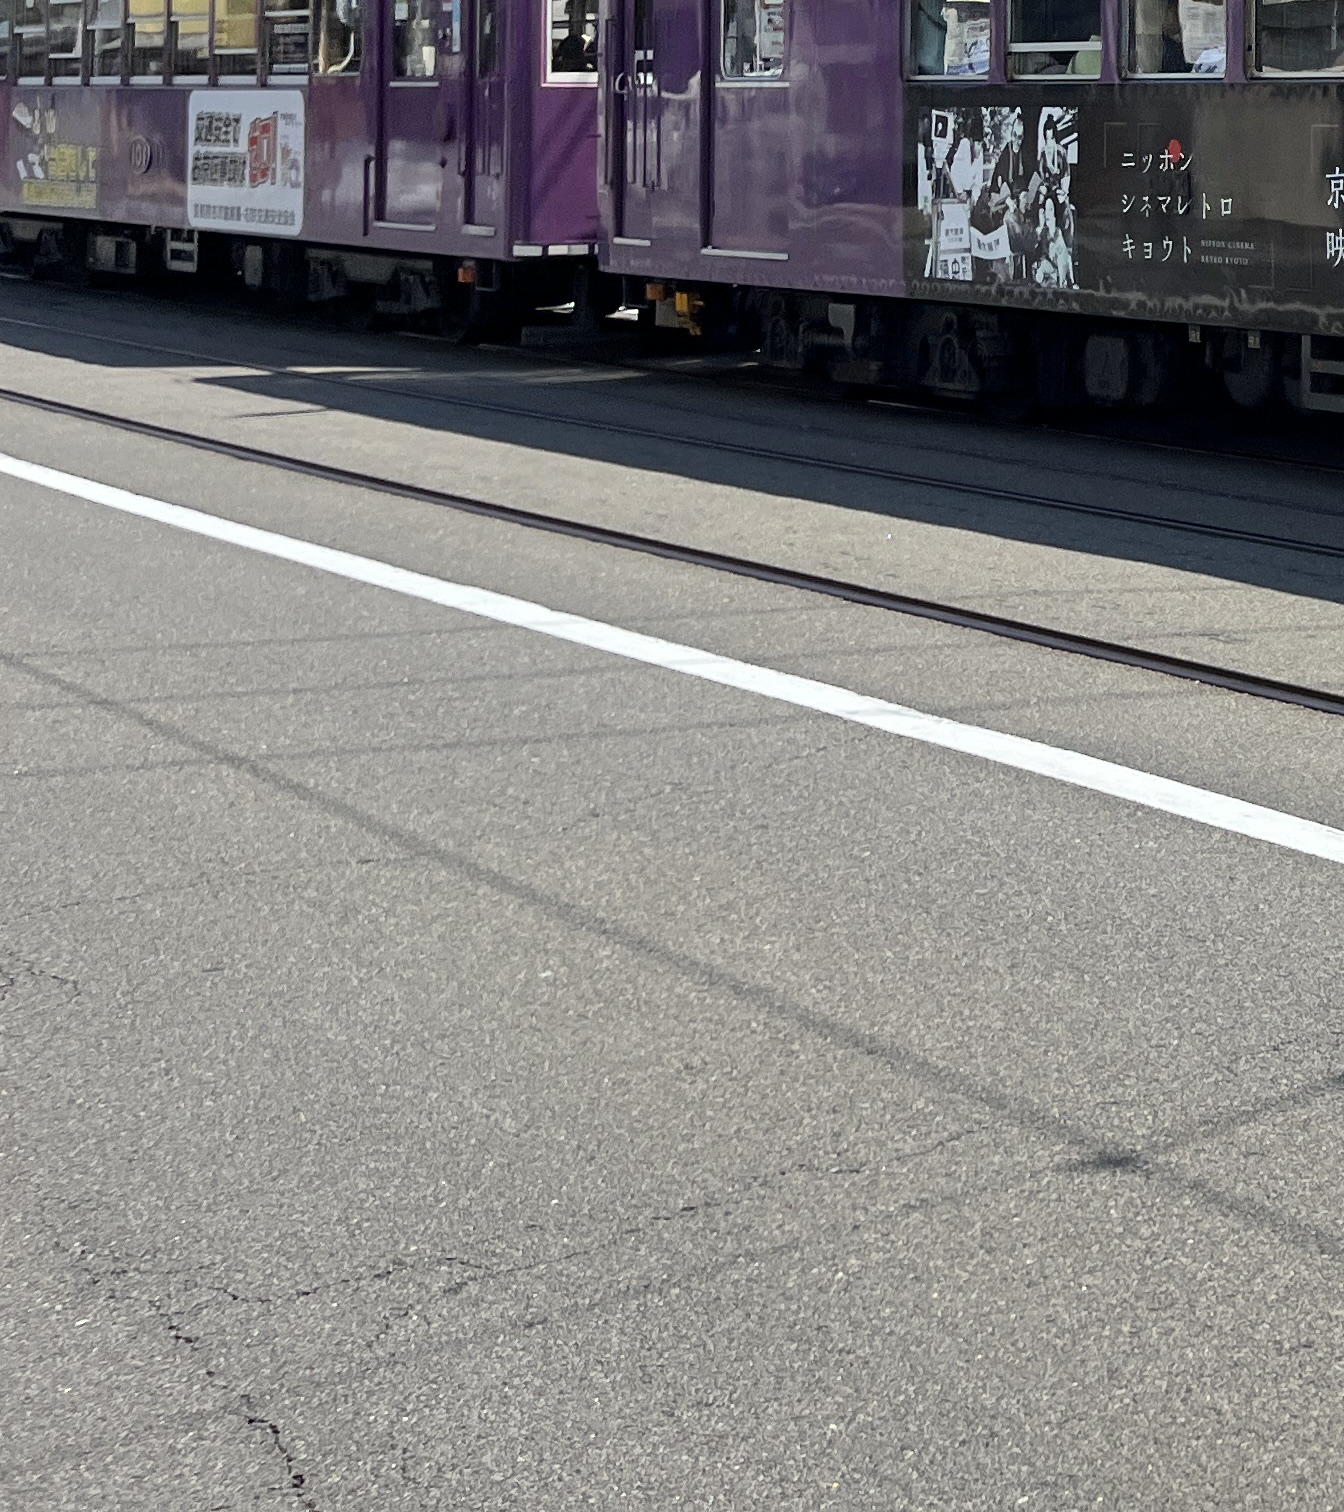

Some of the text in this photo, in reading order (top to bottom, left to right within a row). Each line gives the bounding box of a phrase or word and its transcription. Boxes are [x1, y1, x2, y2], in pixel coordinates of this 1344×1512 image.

[1121, 192, 1233, 220] シネマレトロ
[1122, 233, 1192, 264] キョウト
